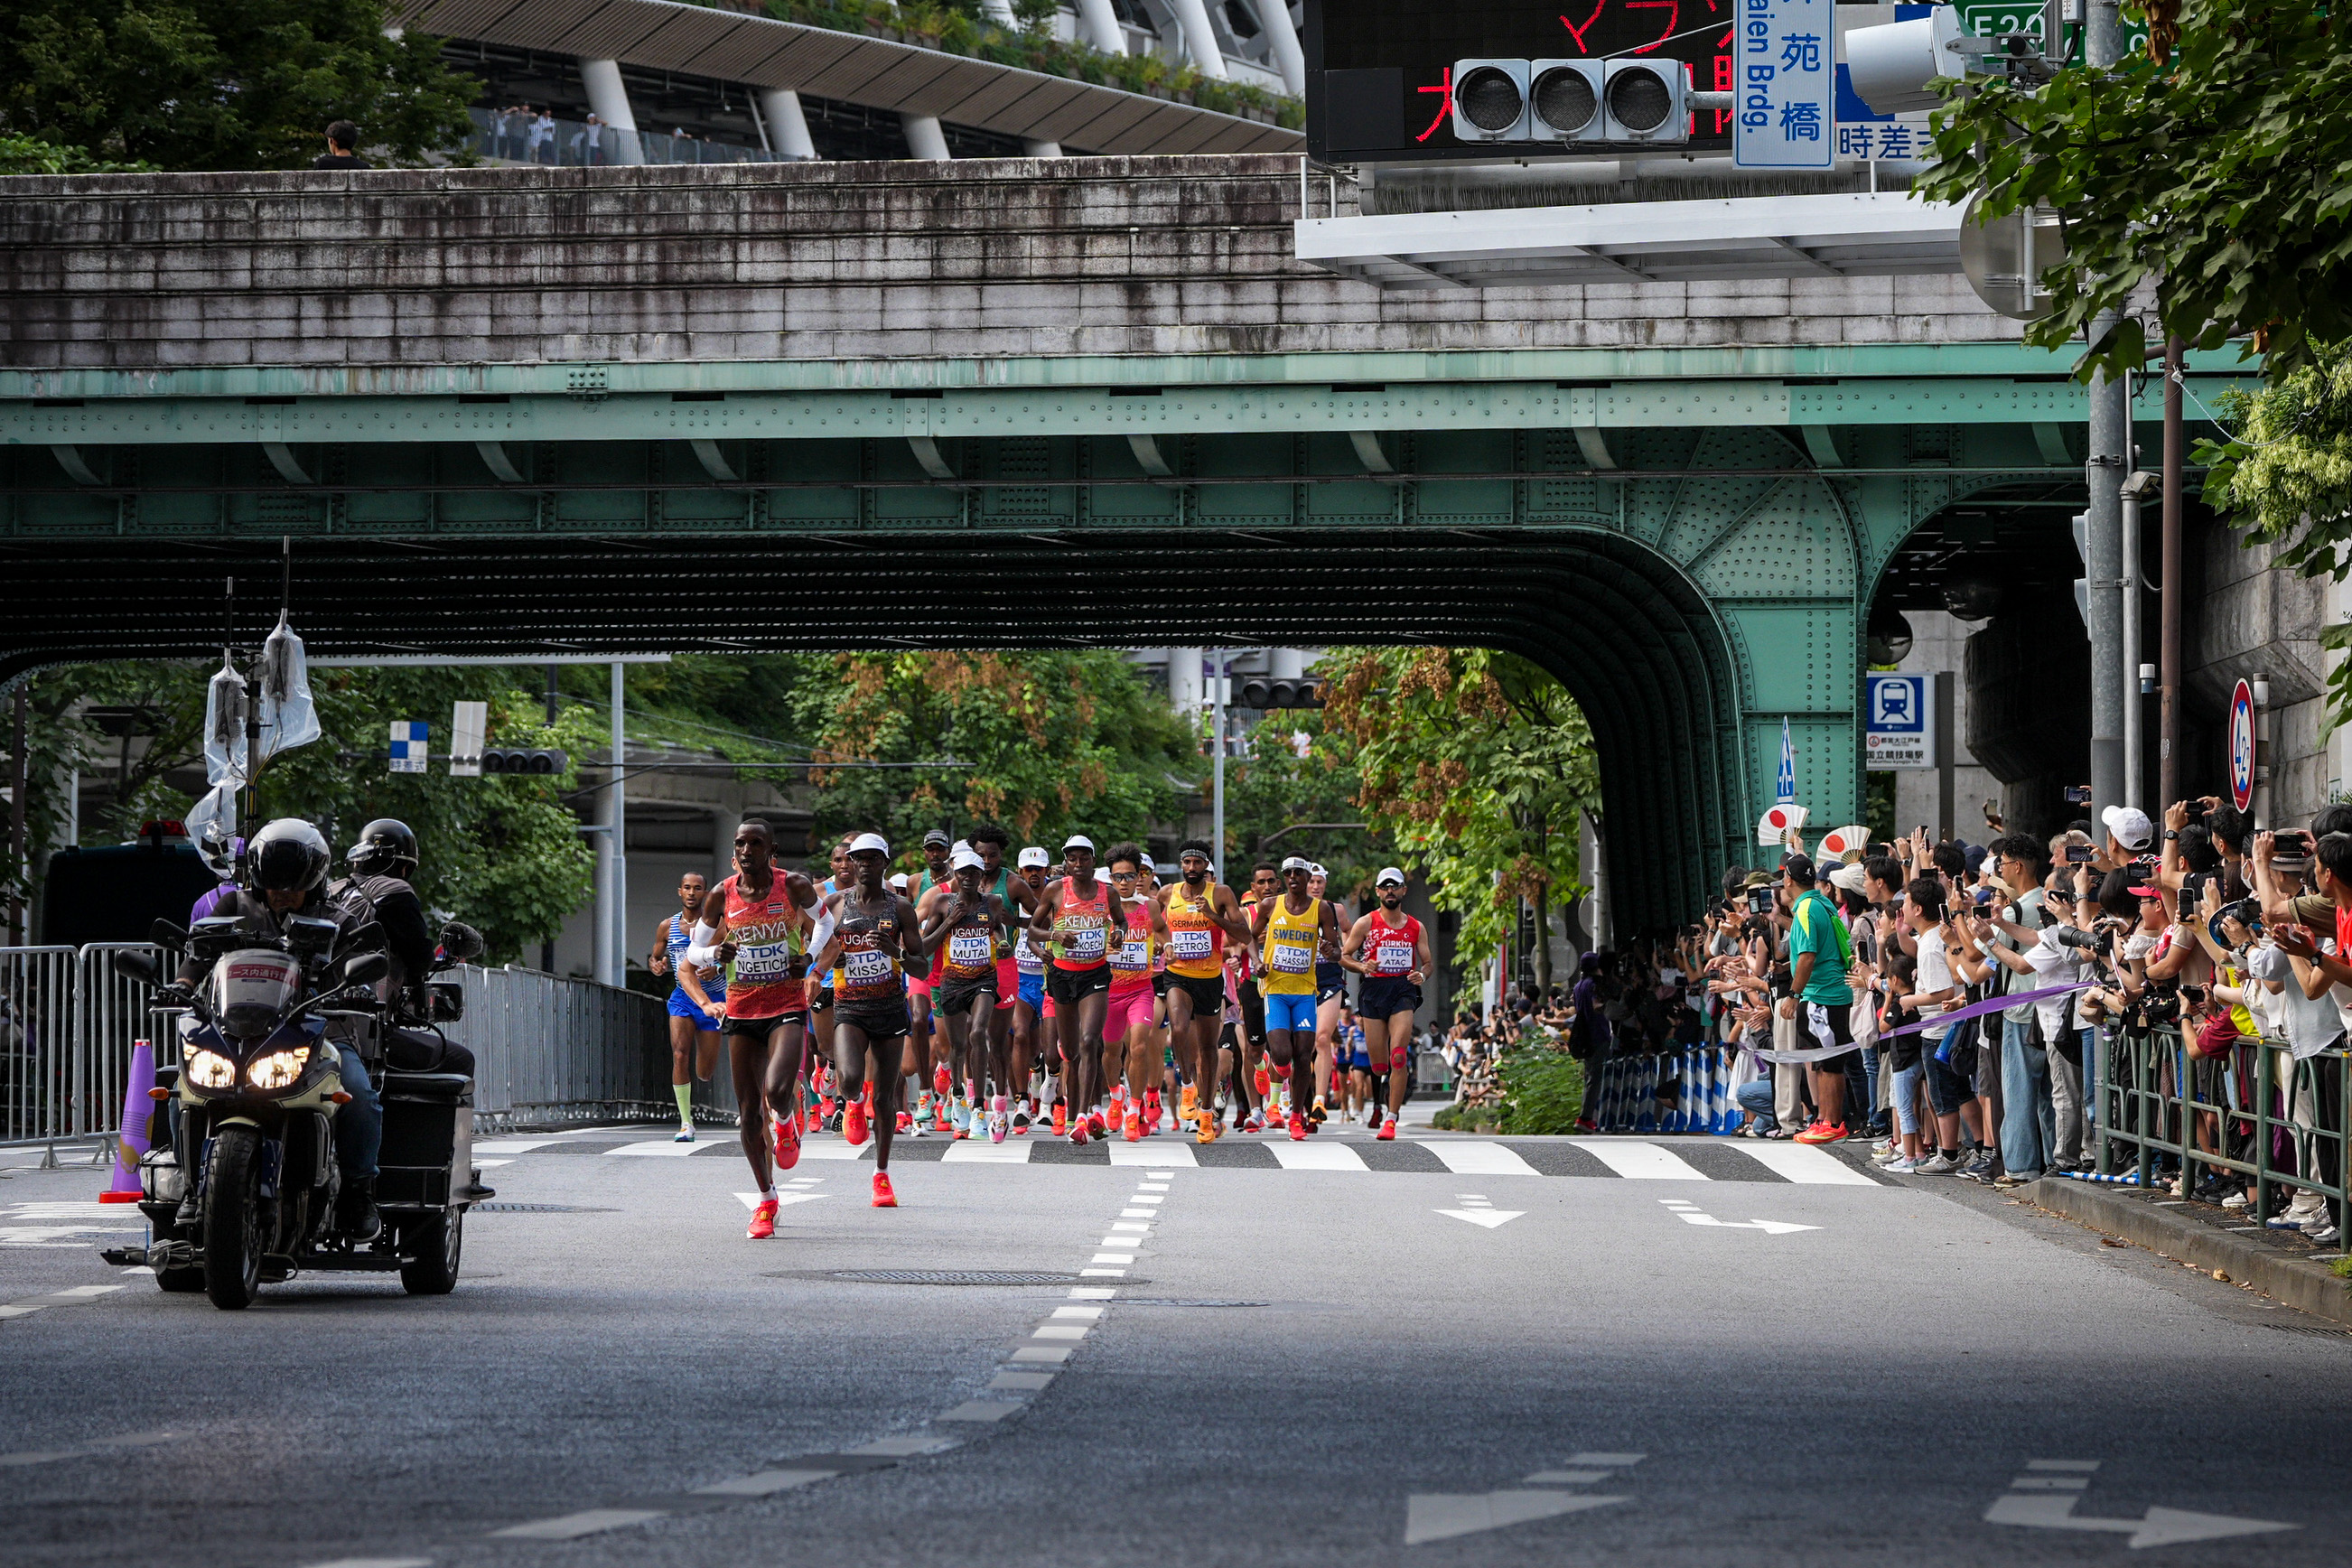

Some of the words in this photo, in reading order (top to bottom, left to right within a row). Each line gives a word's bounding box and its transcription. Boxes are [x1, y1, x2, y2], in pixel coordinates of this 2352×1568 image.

[1741, 65, 1775, 134] Brdg.
[1064, 915, 1104, 928] KENYA
[1171, 919, 1209, 928] GERMANY
[732, 921, 788, 942] KENYA
[951, 927, 990, 938] UGANDA
[1079, 929, 1103, 939] TDK
[1181, 932, 1208, 940] TDK
[1273, 929, 1315, 942] SWEDEN
[960, 937, 988, 947] TDK
[1174, 941, 1210, 951] PETROS
[747, 943, 785, 958] TDK
[953, 947, 988, 958] MUTAI
[1285, 947, 1310, 957] TDK
[1388, 948, 1411, 957] TDK
[854, 951, 888, 964] TDK
[1120, 954, 1135, 962] HE
[1274, 955, 1282, 964] S.
[1281, 956, 1310, 966] HASSAN
[1384, 958, 1406, 966] ATAÇ
[737, 957, 788, 973] NGETICH
[848, 962, 888, 977] KISSA
